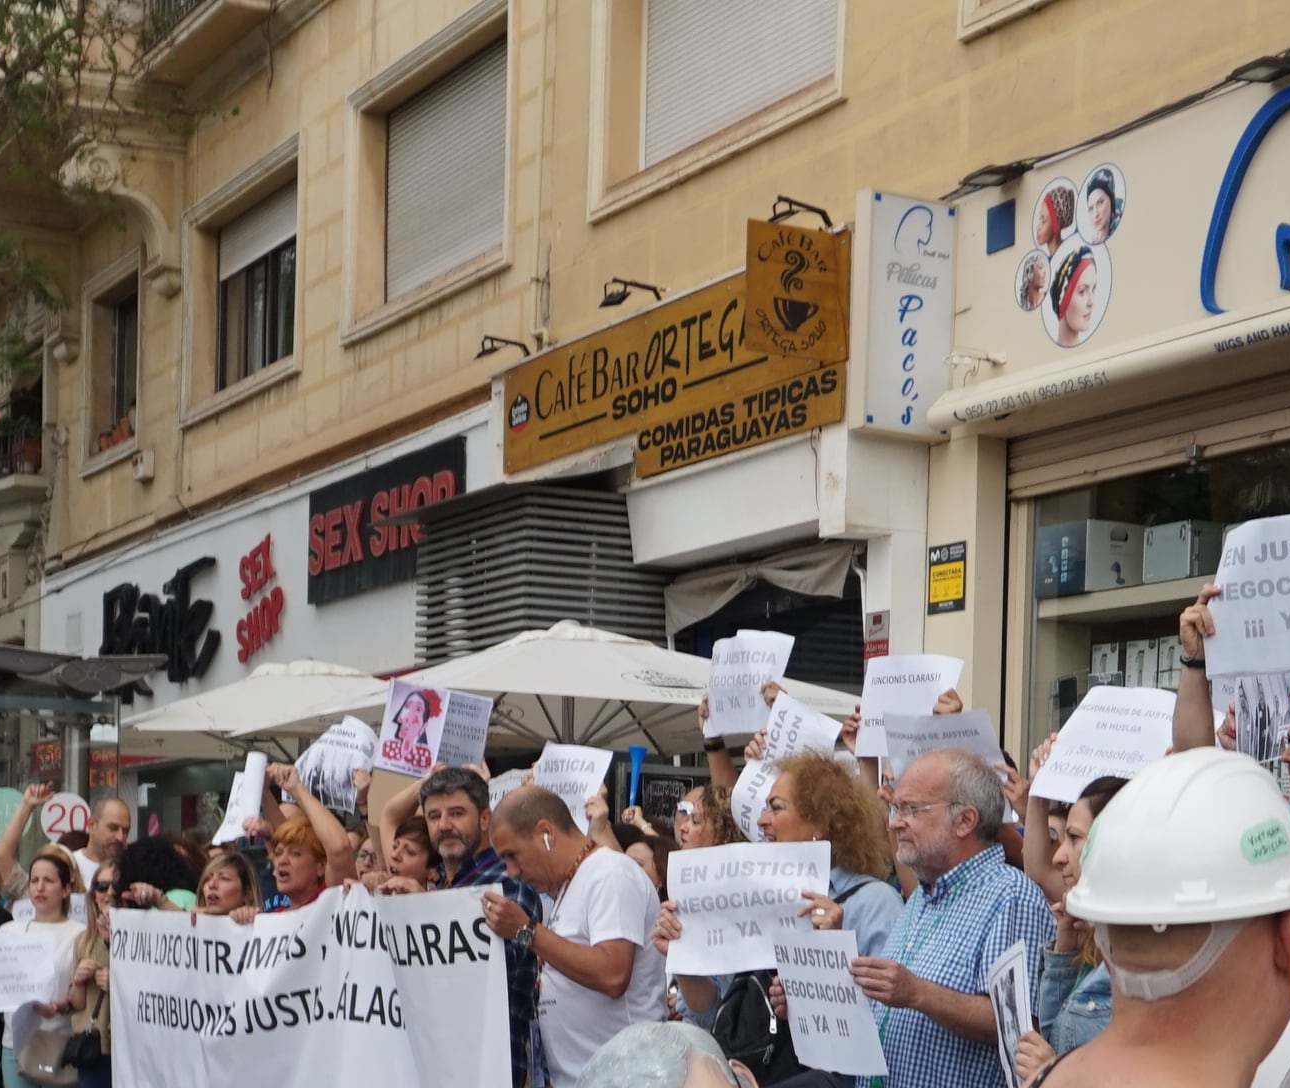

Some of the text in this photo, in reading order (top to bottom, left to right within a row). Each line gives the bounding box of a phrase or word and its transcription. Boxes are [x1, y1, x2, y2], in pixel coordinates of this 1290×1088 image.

[1214, 334, 1245, 354] WIGS
[1247, 328, 1270, 347] AND
[612, 378, 677, 421] SOHO
[638, 367, 839, 452] COMIDAS TIPICAS
[965, 401, 988, 421] 952
[1038, 383, 1060, 402] 952
[1061, 379, 1077, 396] 22
[1095, 371, 1109, 389] 51
[660, 404, 808, 467] PARAGUAYAS
[309, 499, 365, 577] SEX
[1223, 545, 1246, 567] EN
[239, 532, 277, 601] SEX
[236, 586, 284, 664] SHOP
[749, 709, 788, 801] JUSTICIA
[46, 803, 90, 835] 20
[679, 859, 821, 885] EN JUSTICIA
[130, 929, 152, 964] UNA
[735, 918, 763, 940] YA
[774, 944, 850, 971] EN JUSTICIA
[335, 971, 407, 1031] ÁLAG
[780, 978, 858, 1005] EGOCIACIÓN
[812, 1014, 830, 1034] YA
